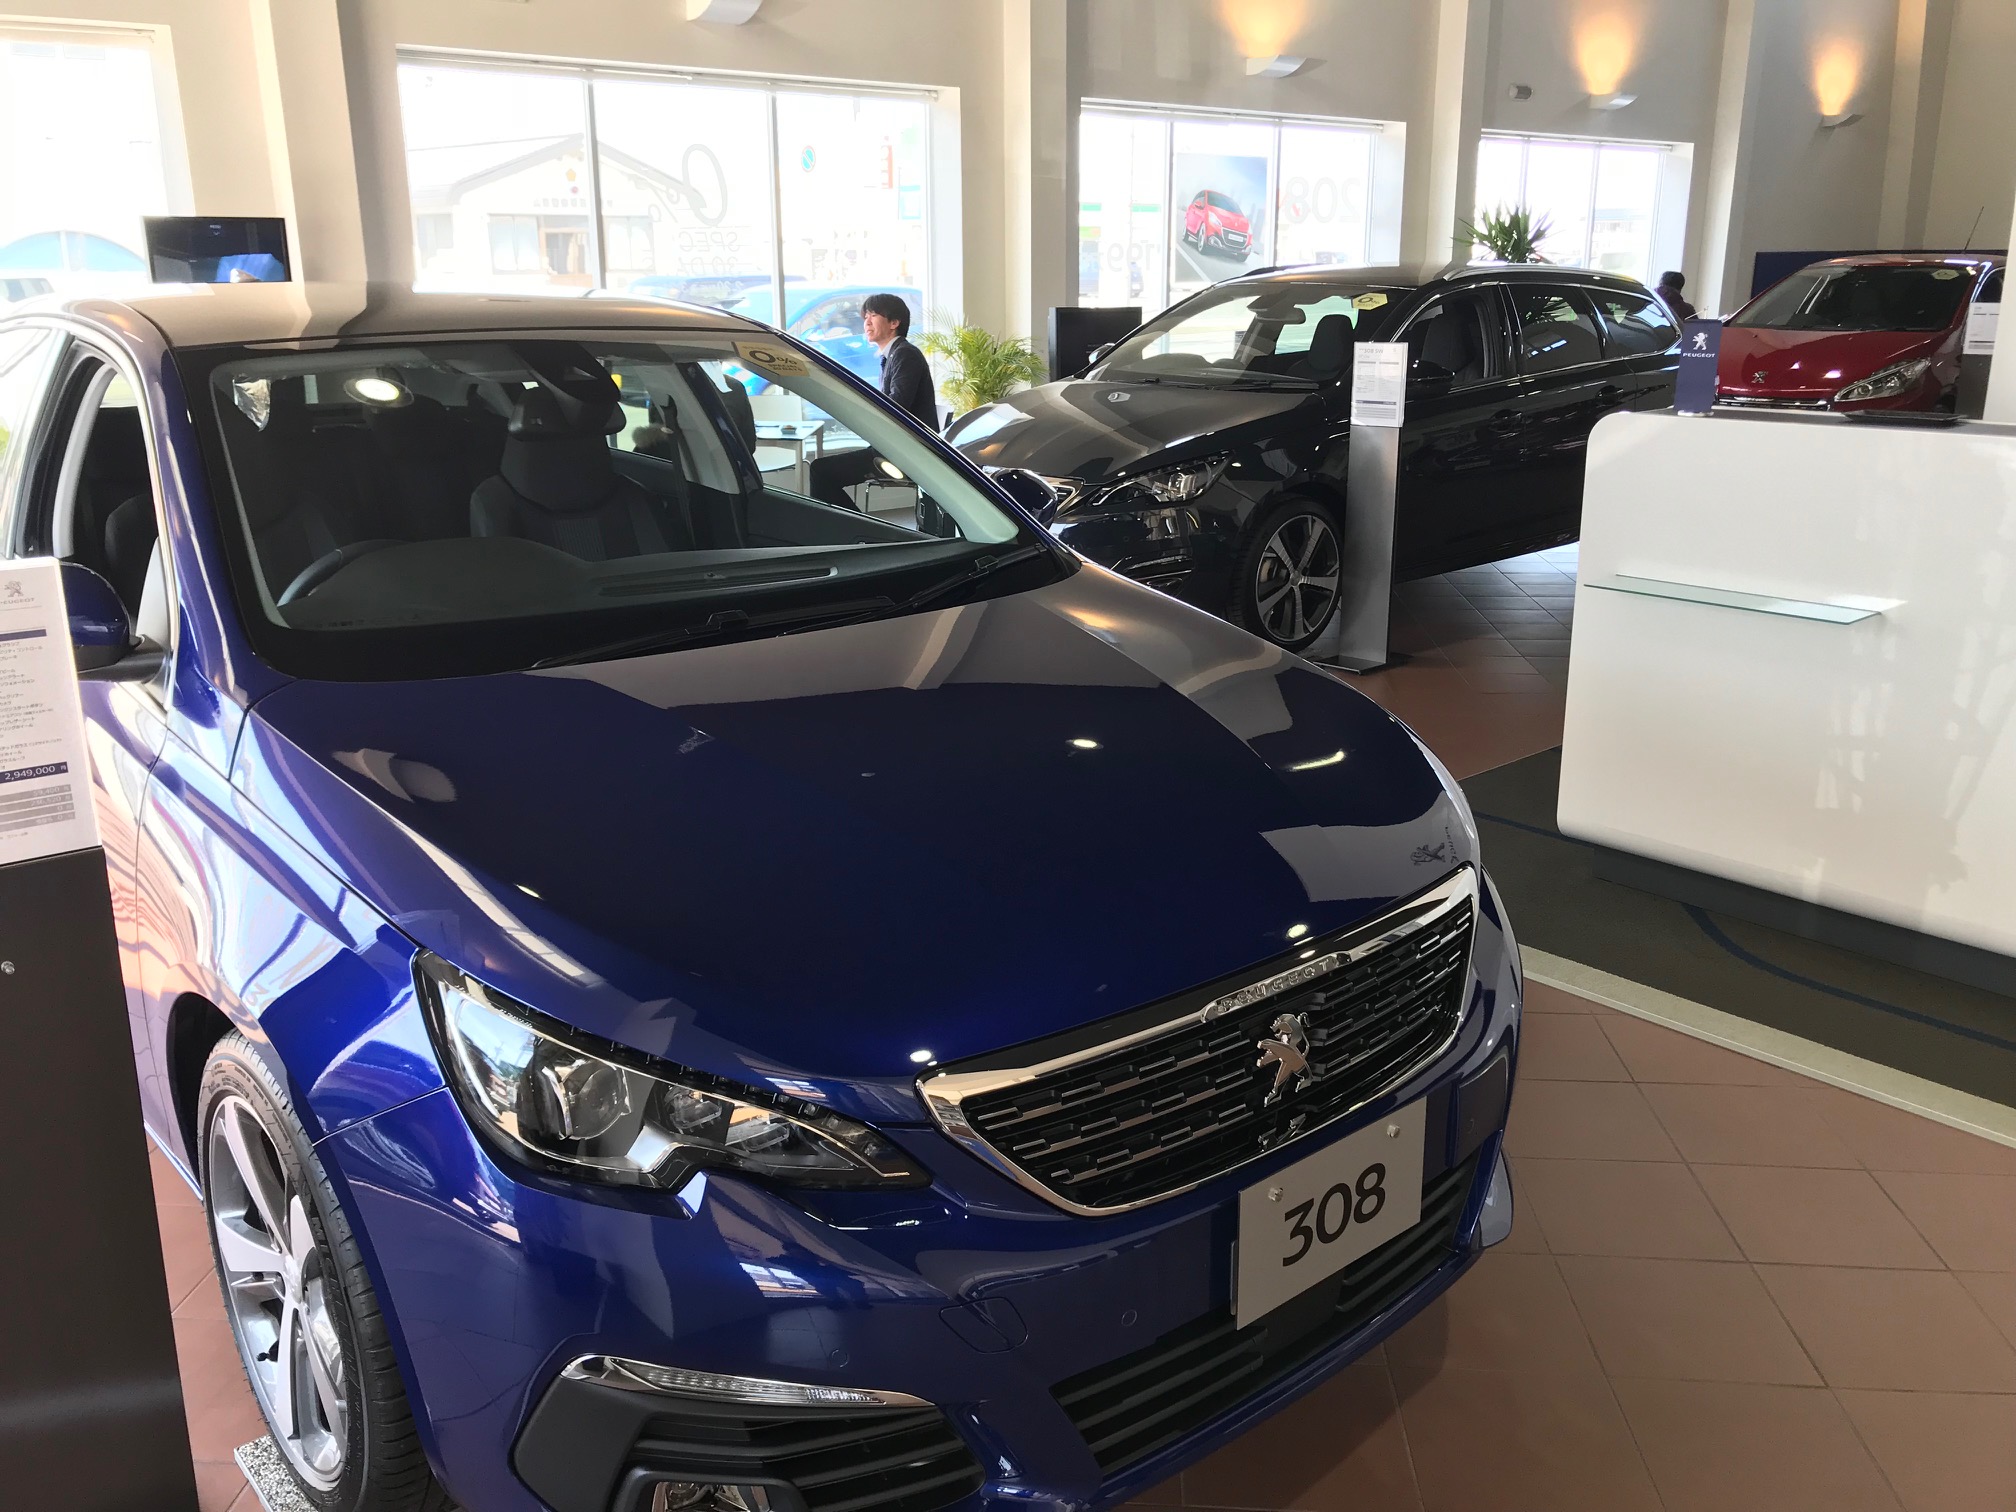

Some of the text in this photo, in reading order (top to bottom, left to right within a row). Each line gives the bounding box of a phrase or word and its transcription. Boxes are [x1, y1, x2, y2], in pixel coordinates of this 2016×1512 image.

[4, 765, 56, 781] 2,949,000
[1216, 958, 1330, 1013] PEUGEOT
[1282, 1162, 1386, 1267] 308
